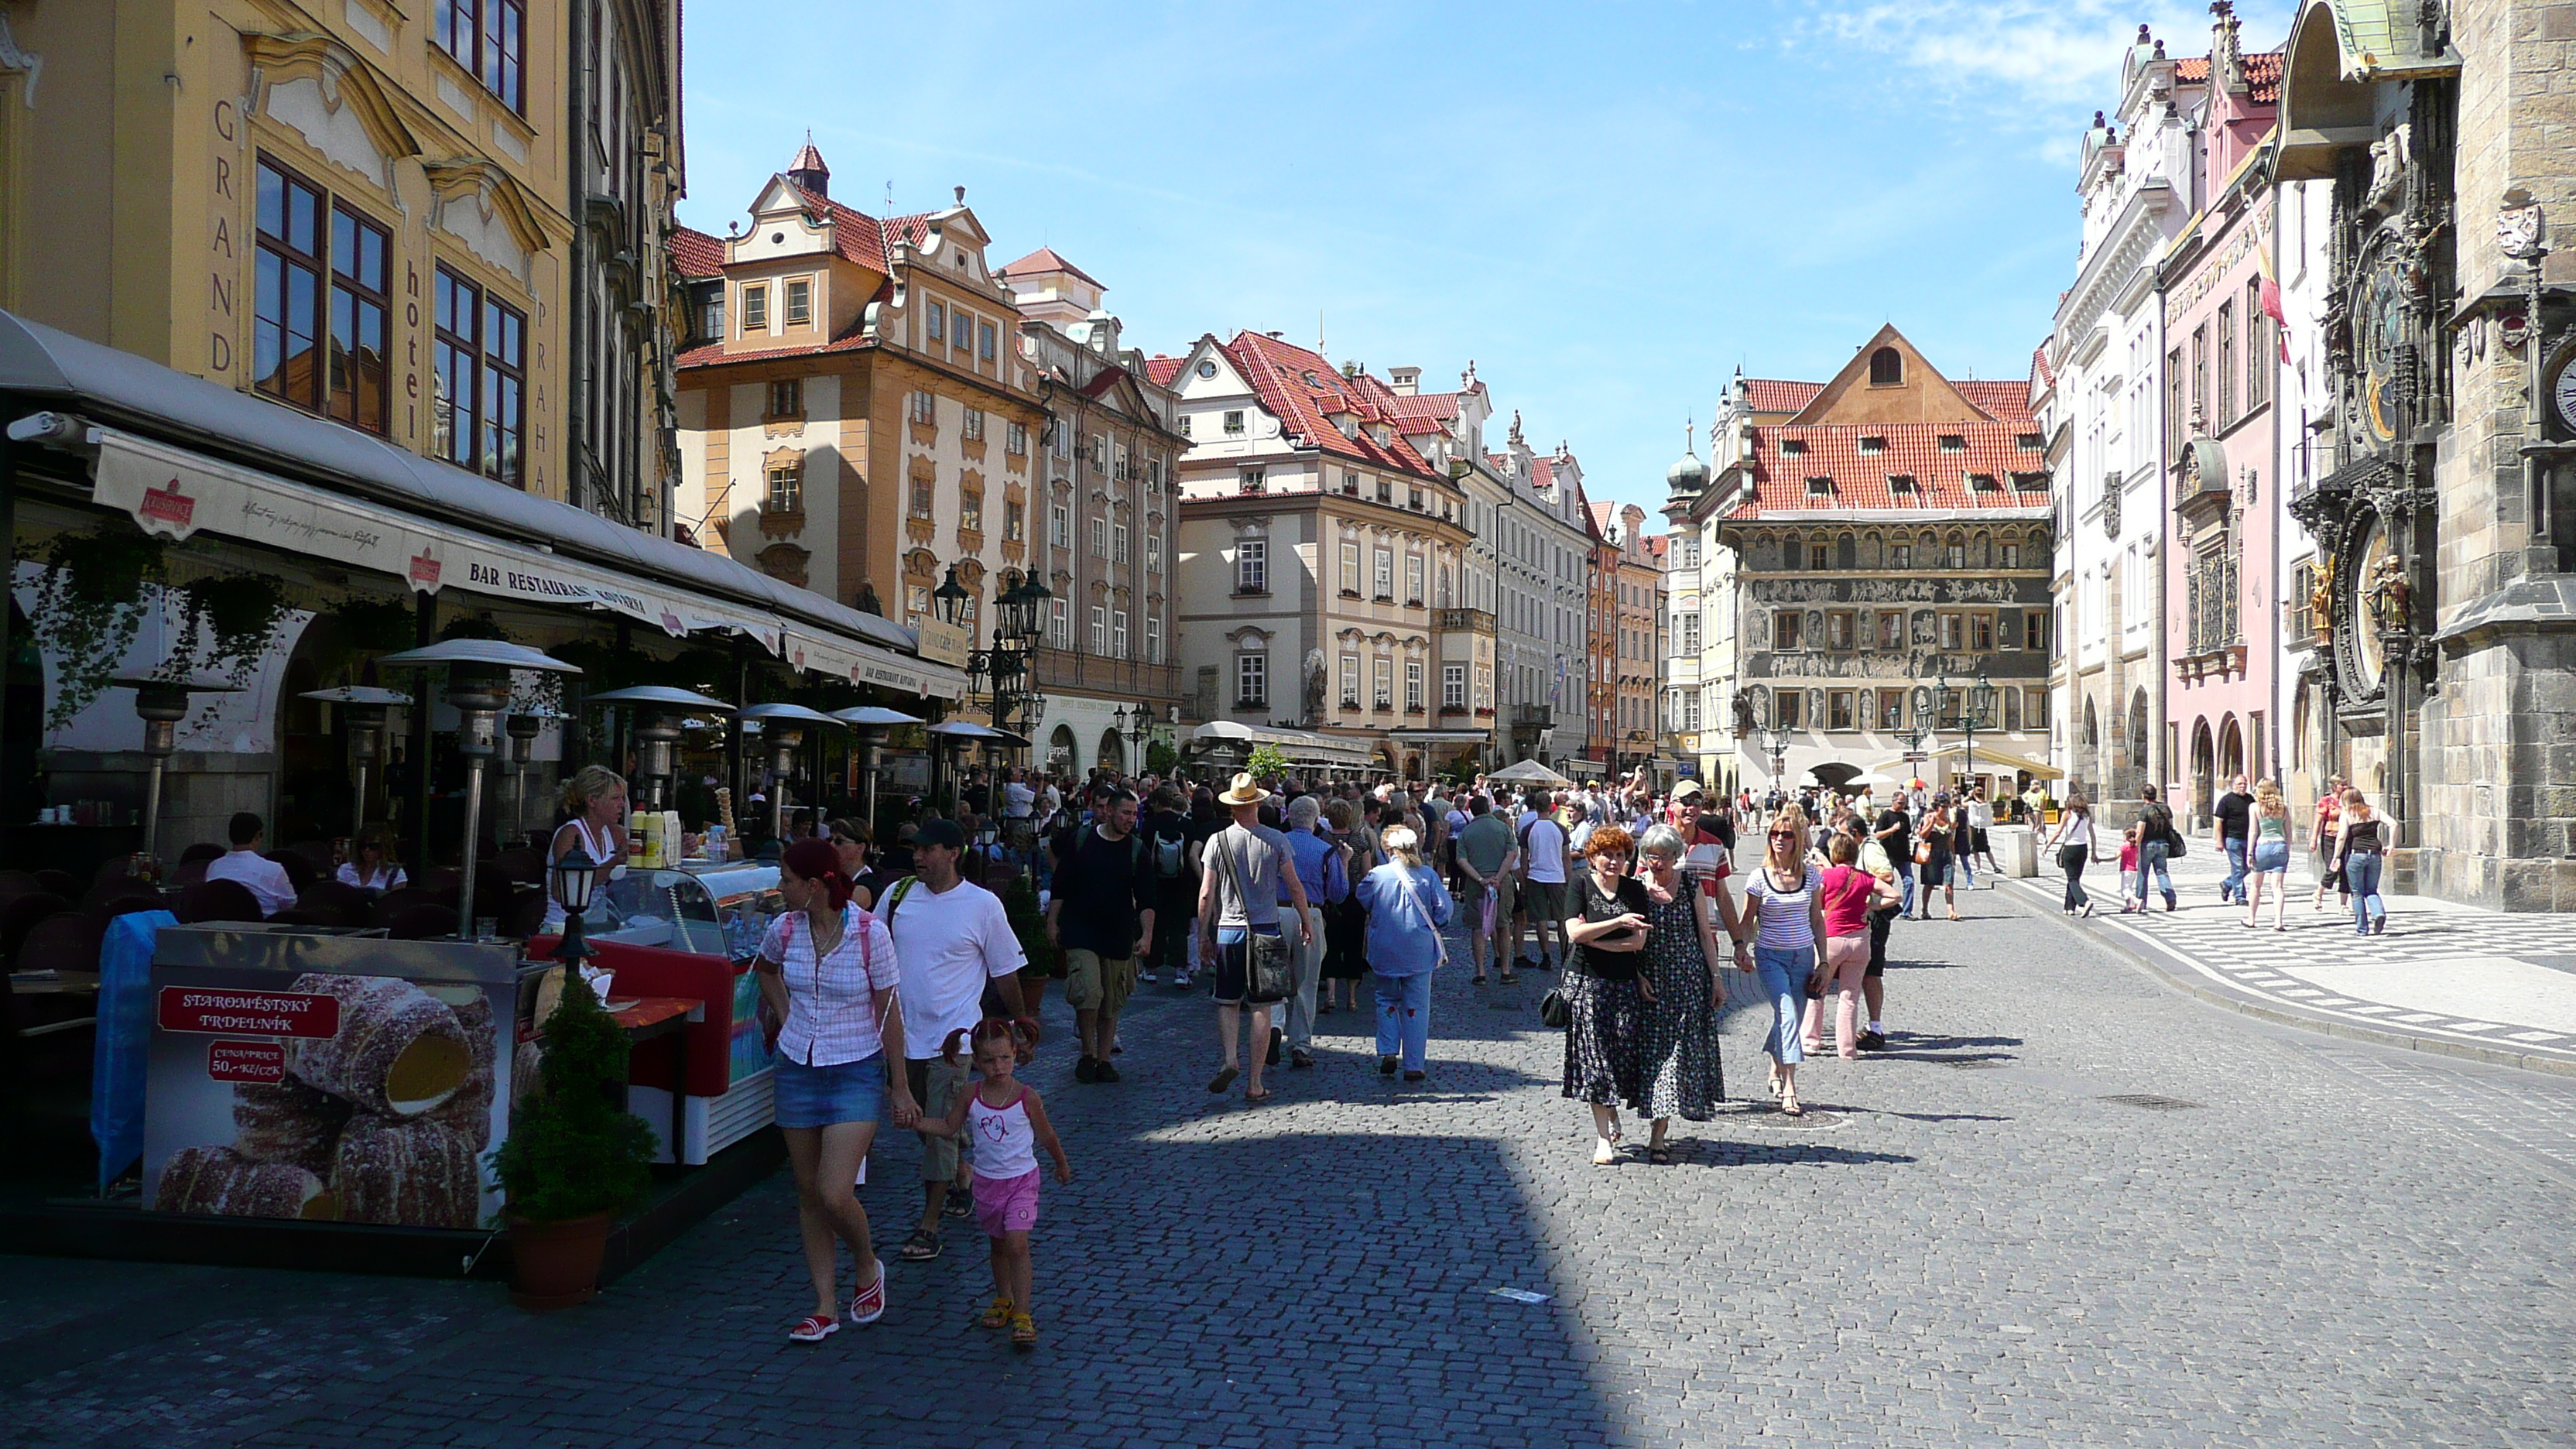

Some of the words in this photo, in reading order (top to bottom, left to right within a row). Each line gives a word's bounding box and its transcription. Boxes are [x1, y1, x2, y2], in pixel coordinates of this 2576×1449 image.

[212, 100, 232, 372] GRAND
[406, 259, 419, 439] hotel
[536, 302, 546, 494] PRAHA
[469, 563, 500, 586] BAR
[199, 1014, 293, 1031] TRDELNÍK
